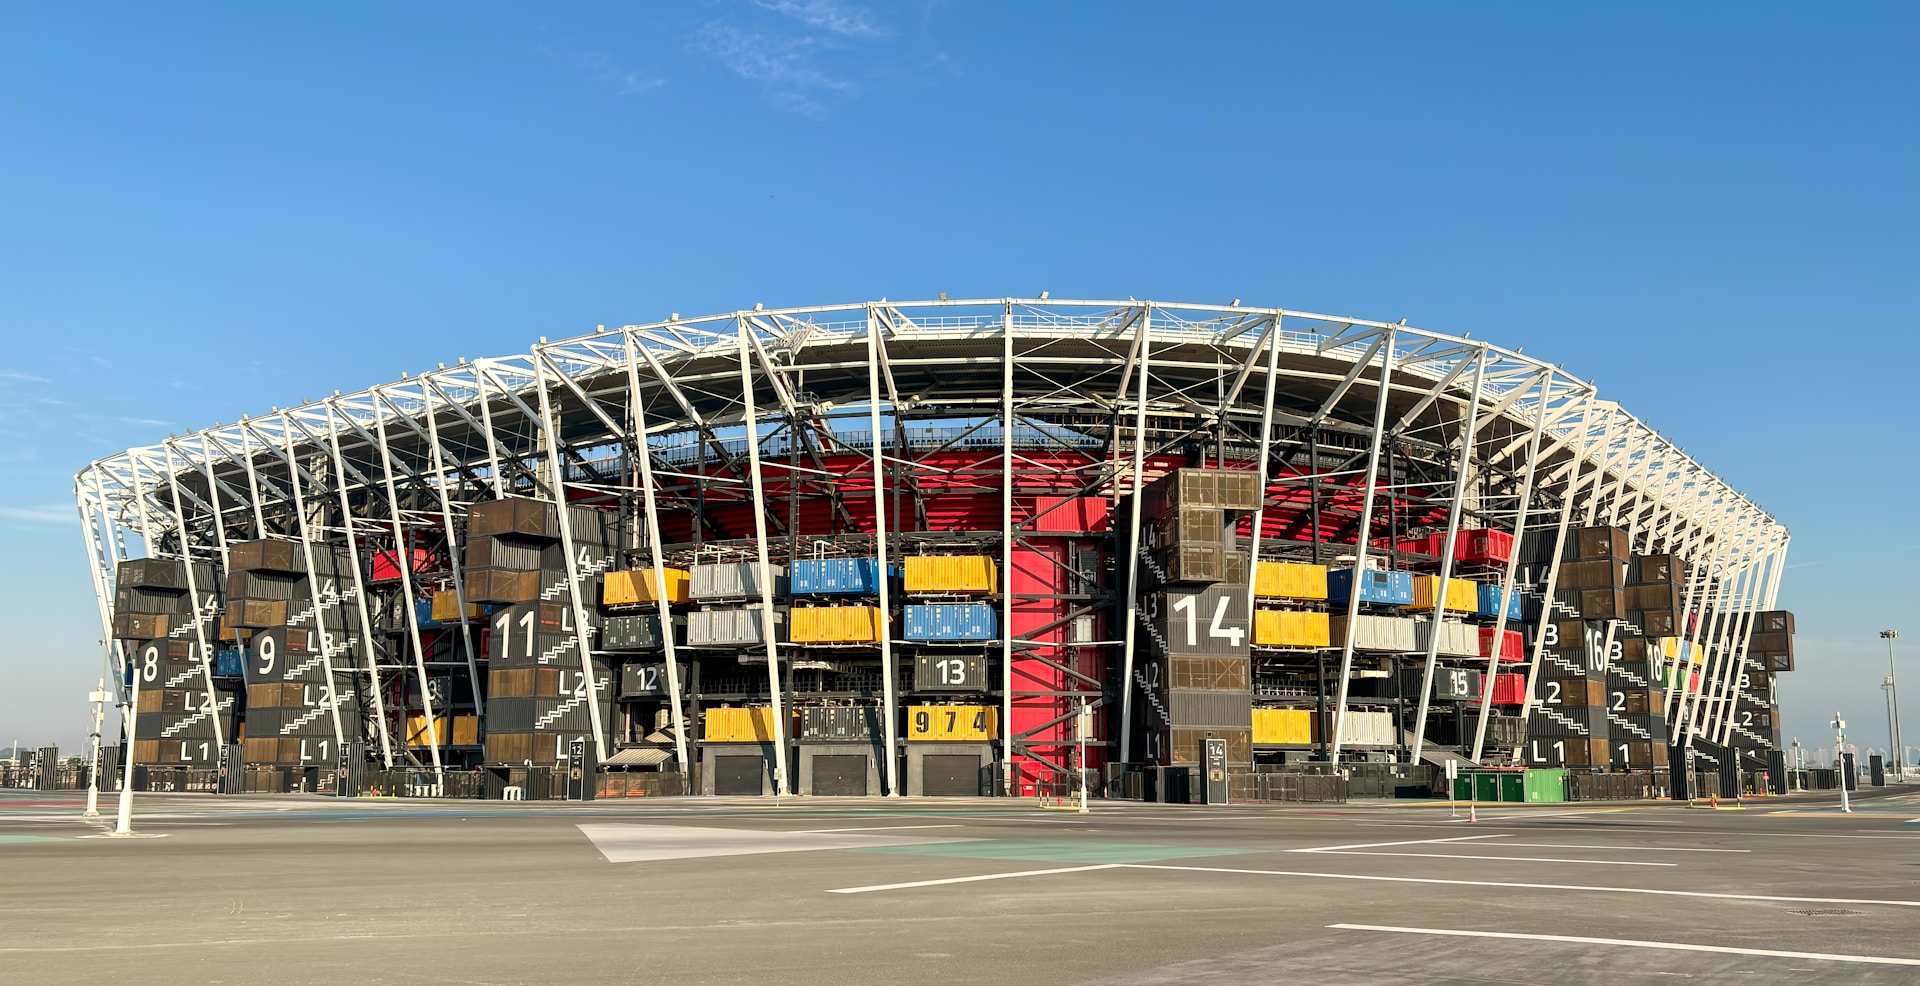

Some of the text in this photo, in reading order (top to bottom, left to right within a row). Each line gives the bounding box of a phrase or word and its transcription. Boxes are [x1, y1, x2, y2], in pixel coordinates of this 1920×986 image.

[1172, 594, 1245, 647] 14
[495, 610, 535, 659] 11
[258, 635, 276, 675] 9
[1586, 628, 1604, 672] 16
[1647, 643, 1663, 682] 18
[143, 646, 159, 682] 8
[935, 659, 966, 685] 13
[1145, 662, 1159, 688] L2
[559, 670, 586, 694] L2
[636, 666, 658, 691] 12
[1450, 671, 1469, 696] 15
[184, 692, 211, 711] L2
[304, 685, 331, 706] L2
[180, 742, 209, 761] L1
[301, 739, 329, 761] L1
[572, 746, 582, 755] 12
[1146, 733, 1160, 759] L1
[1210, 745, 1223, 756] 14
[1532, 740, 1565, 762] L1
